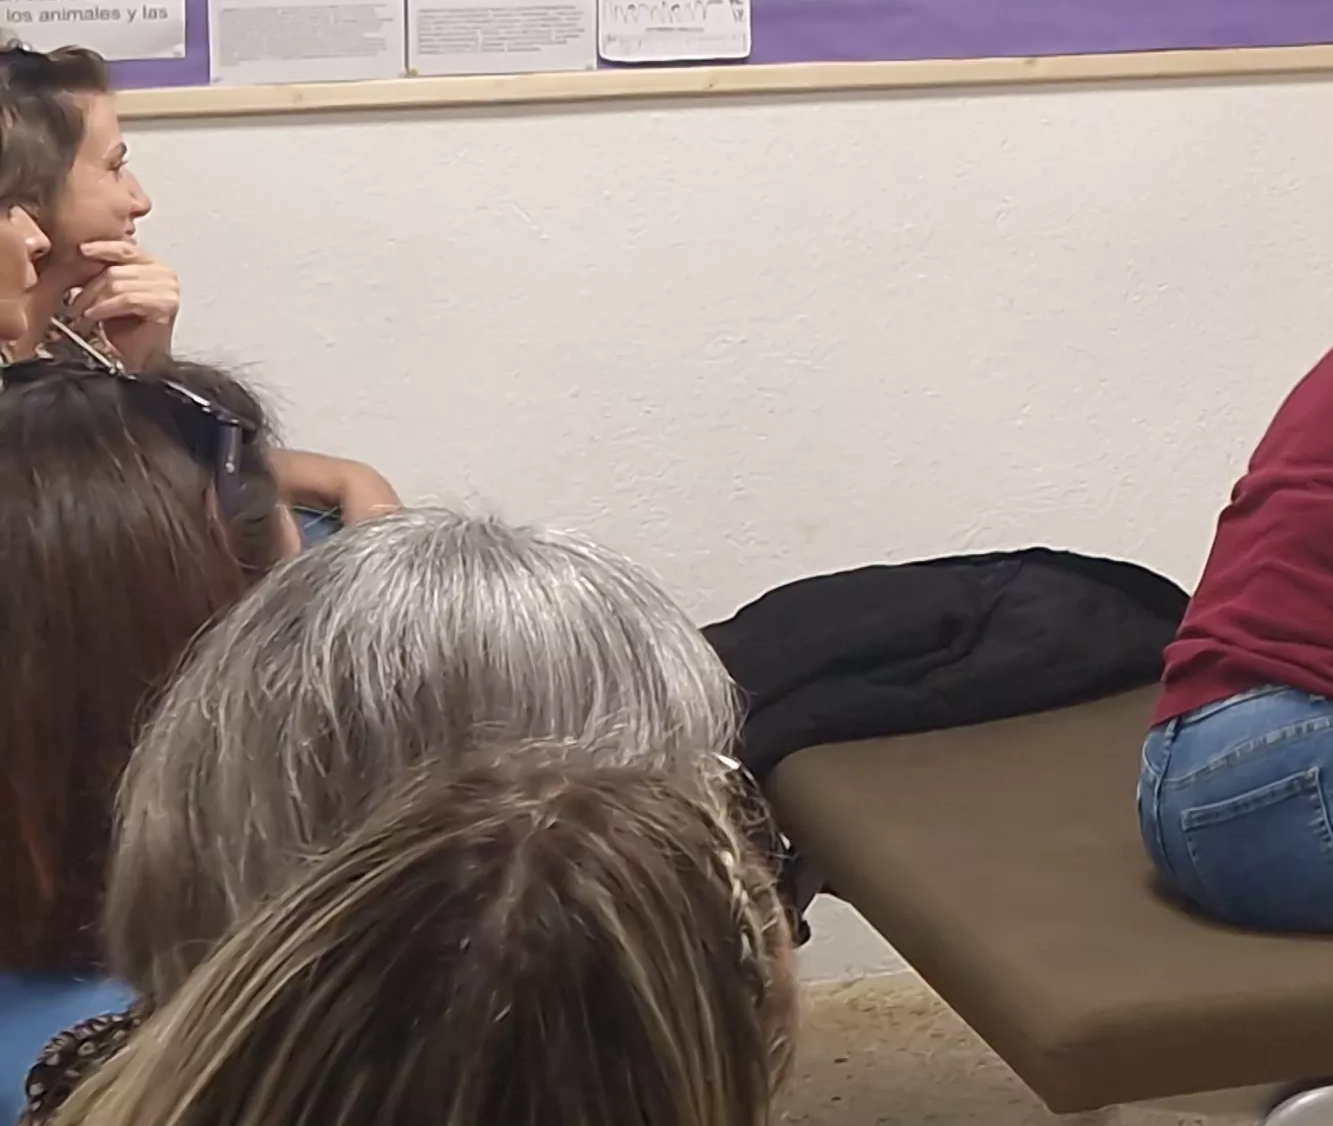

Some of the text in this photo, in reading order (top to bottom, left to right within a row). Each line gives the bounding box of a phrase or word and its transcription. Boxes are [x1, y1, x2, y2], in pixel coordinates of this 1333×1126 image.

[6, 4, 168, 23] los animales y las
